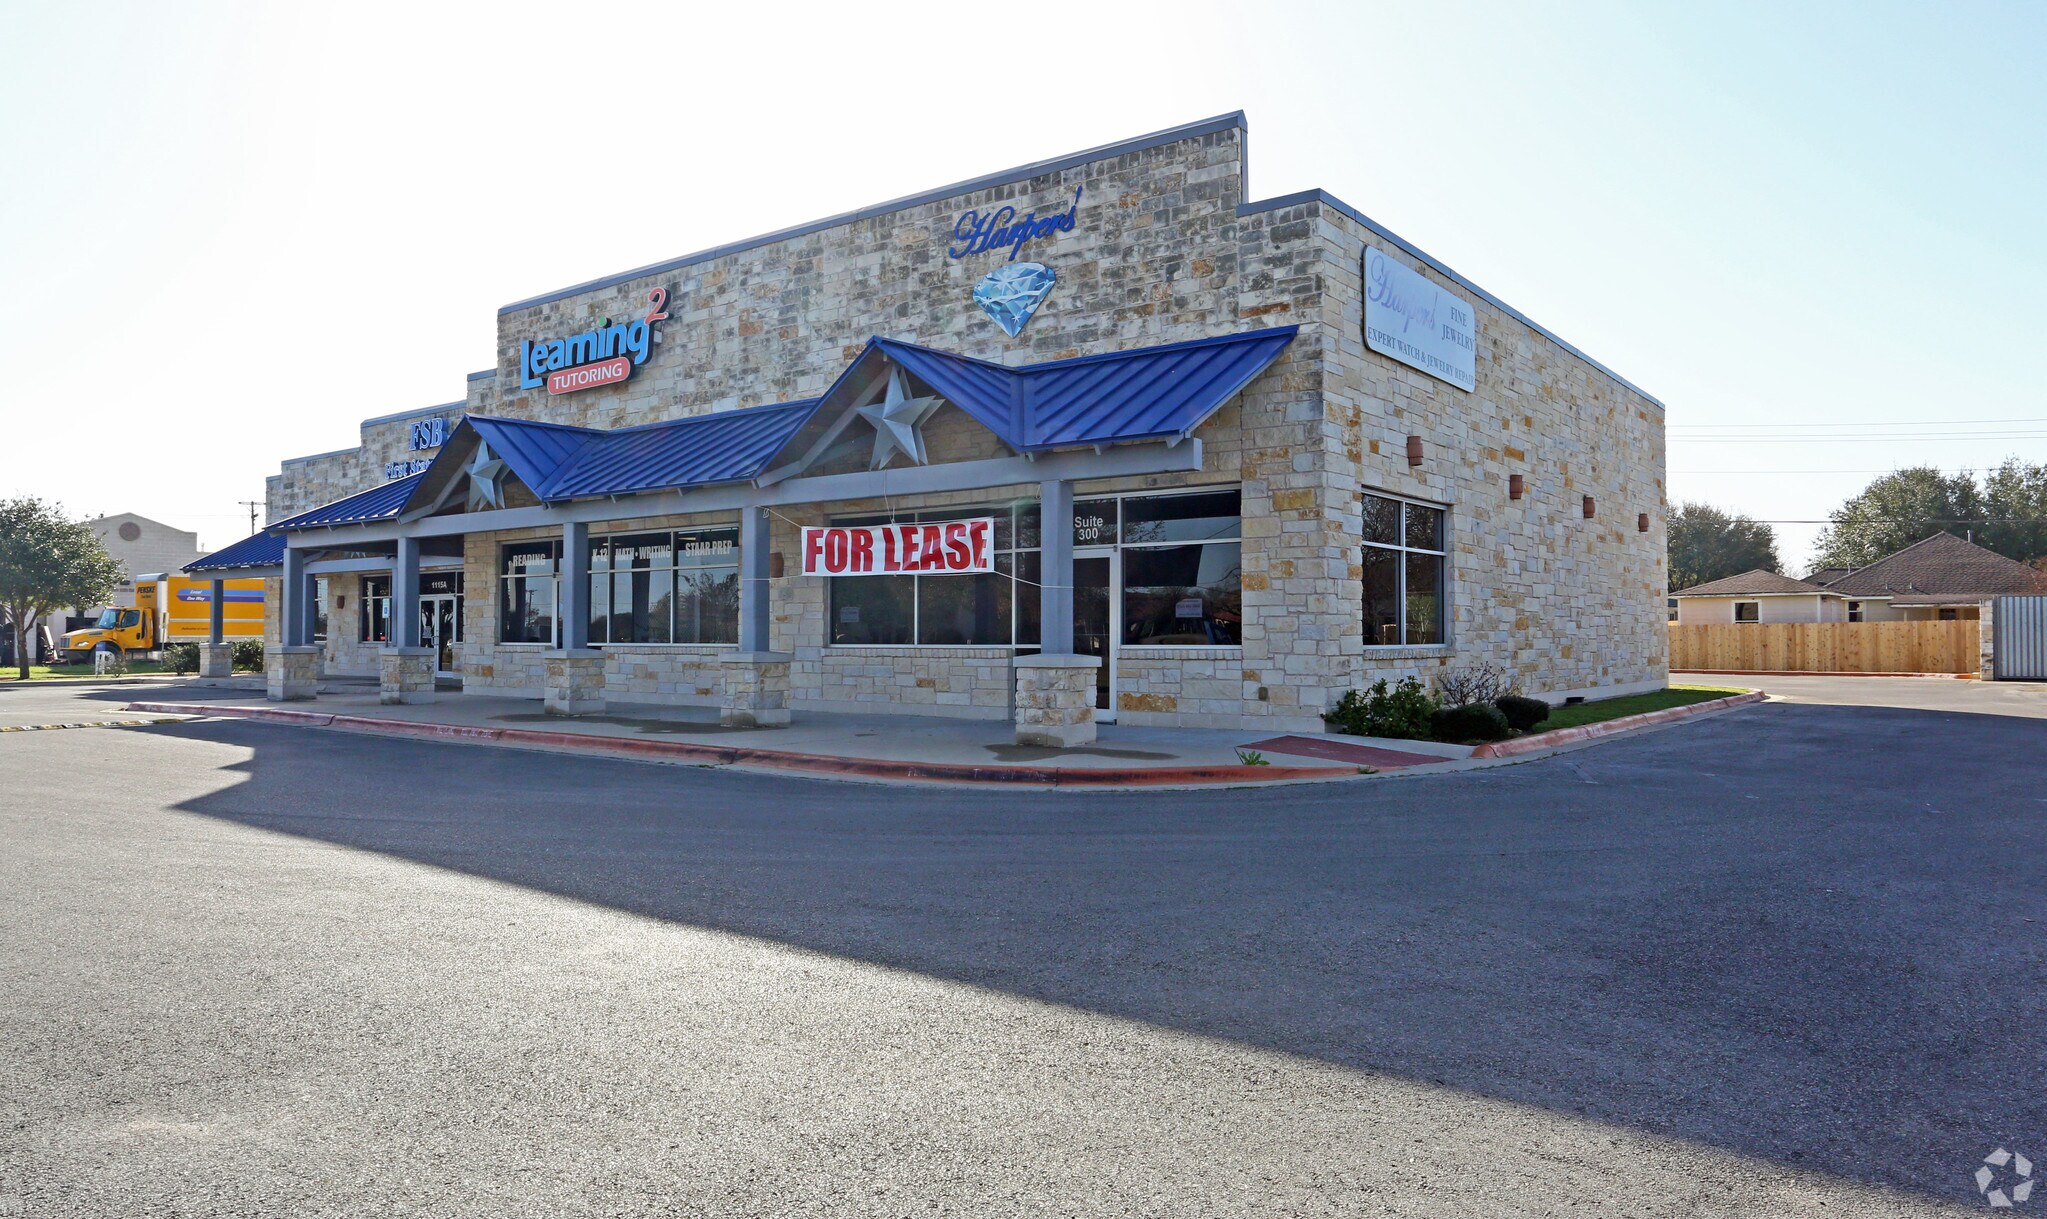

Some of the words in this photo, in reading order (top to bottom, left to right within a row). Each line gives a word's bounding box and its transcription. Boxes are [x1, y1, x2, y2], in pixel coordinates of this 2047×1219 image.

[1450, 305, 1468, 328] FINE
[1441, 324, 1475, 352] JEWELRY
[1367, 326, 1397, 350] EXPERT
[1397, 339, 1420, 361] WATCH
[1426, 354, 1455, 377] JEWELRY
[1454, 367, 1475, 386] REPAIR
[553, 362, 623, 390] TUTORING
[409, 417, 444, 451] FSB
[1074, 515, 1104, 528] Suite
[1078, 527, 1099, 541] 300
[614, 547, 635, 561] MATH
[639, 544, 671, 559] WRITING
[685, 541, 711, 557] STAAR
[711, 540, 733, 555] PREP
[804, 528, 874, 574] FOR
[881, 520, 989, 572] LEASE
[512, 553, 546, 567] READING
[431, 581, 447, 589] 1115A
